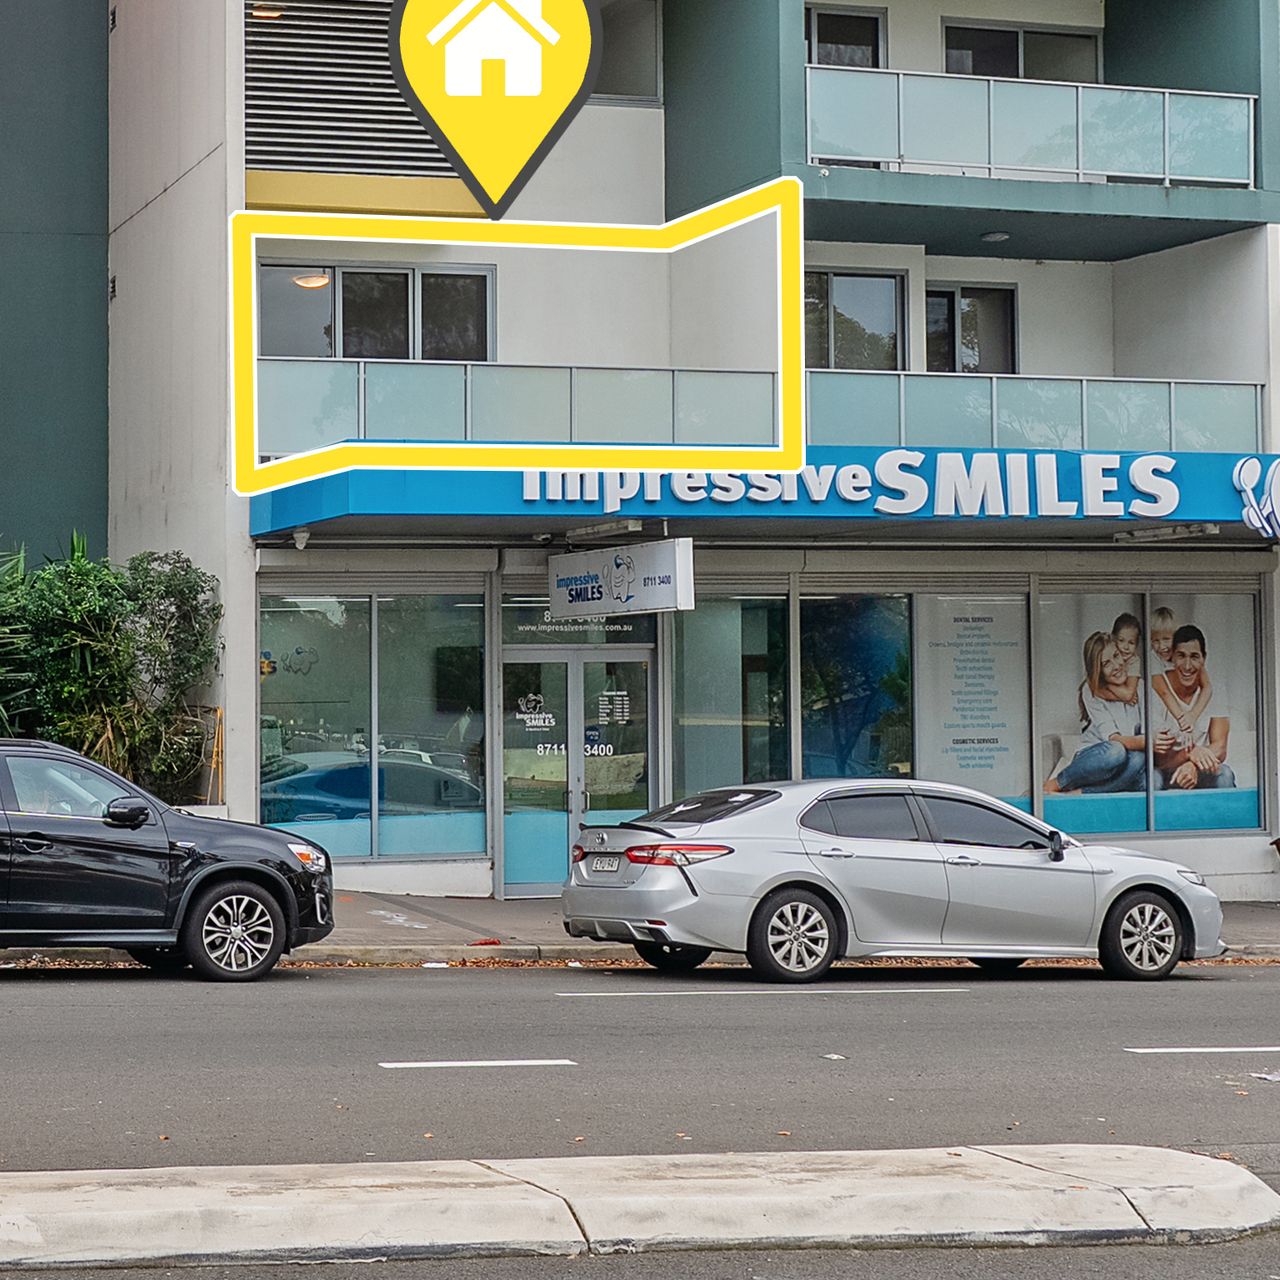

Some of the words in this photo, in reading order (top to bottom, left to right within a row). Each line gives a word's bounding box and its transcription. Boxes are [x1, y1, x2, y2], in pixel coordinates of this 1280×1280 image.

[874, 449, 1181, 517] SMILES
[643, 576, 656, 587] 8711
[657, 575, 672, 586] 3400
[567, 585, 604, 604] SMILES
[518, 624, 632, 632] www.impressivesmiles.com.au
[525, 718, 556, 727] SMILES
[537, 744, 566, 756] 8711
[584, 744, 614, 756] 3400
